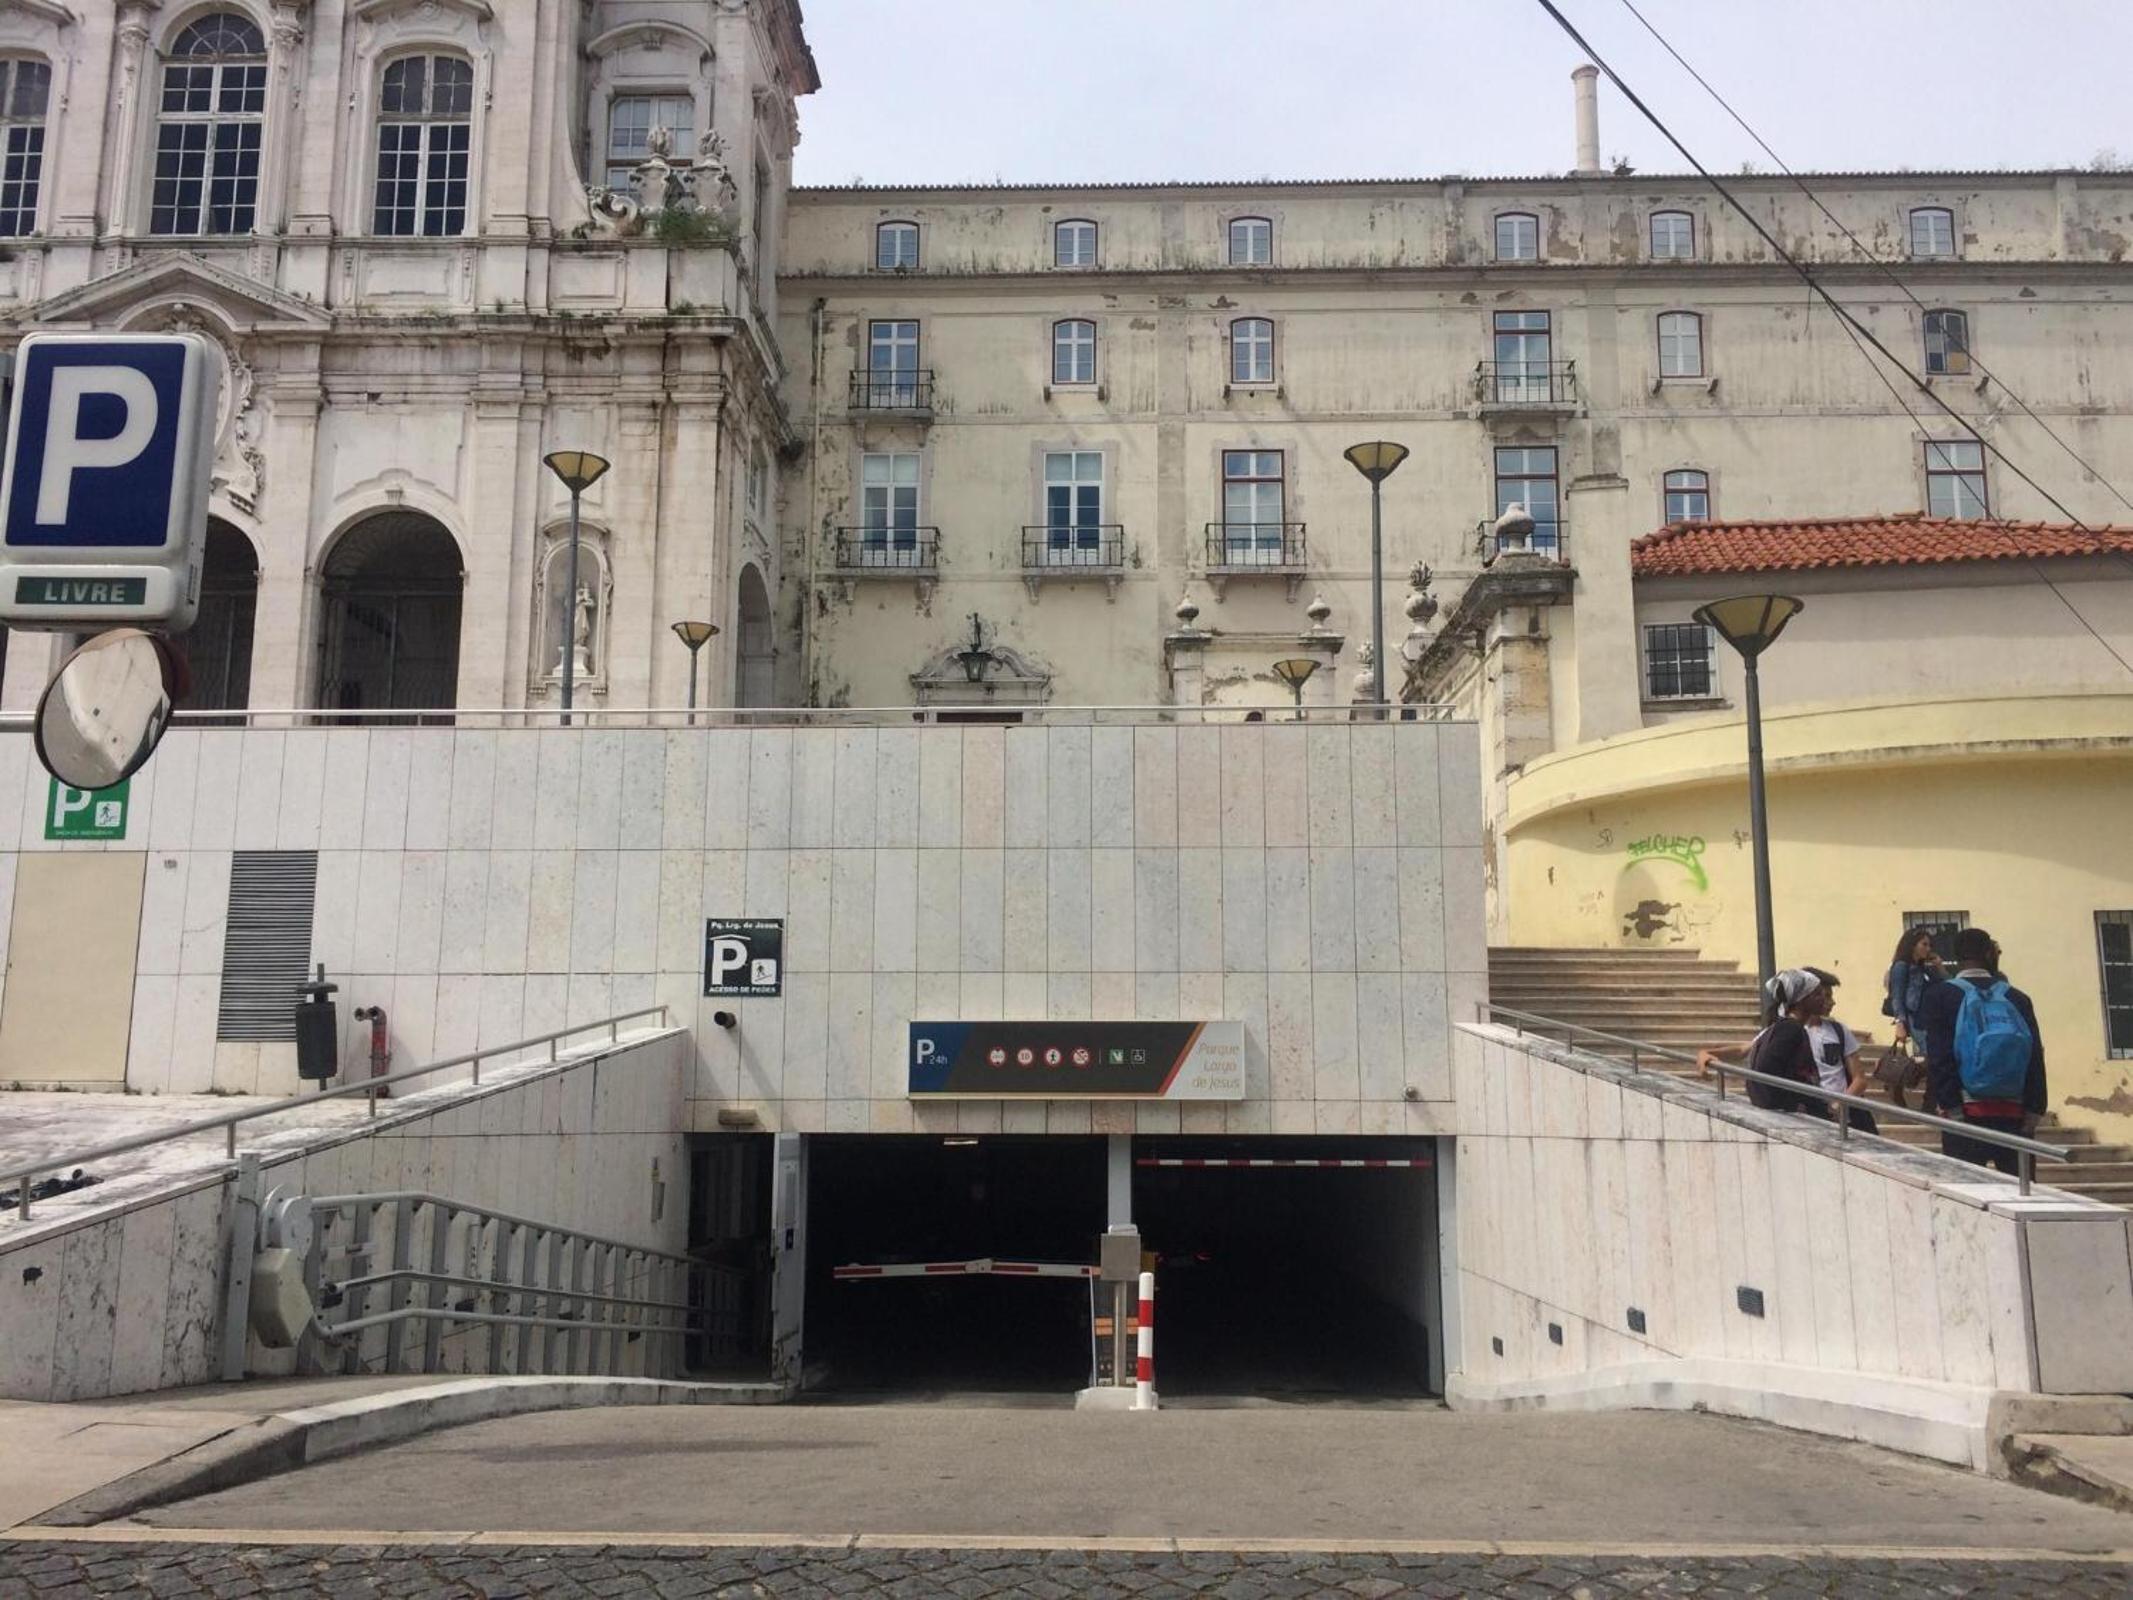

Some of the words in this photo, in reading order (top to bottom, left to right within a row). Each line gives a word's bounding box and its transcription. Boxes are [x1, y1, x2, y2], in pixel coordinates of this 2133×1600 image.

[35, 365, 159, 526] P
[44, 582, 126, 602] LIVRE
[53, 781, 92, 828] P
[743, 921, 753, 929] de
[712, 940, 747, 985] P
[916, 1039, 935, 1064] P
[1192, 1077, 1208, 1088] de
